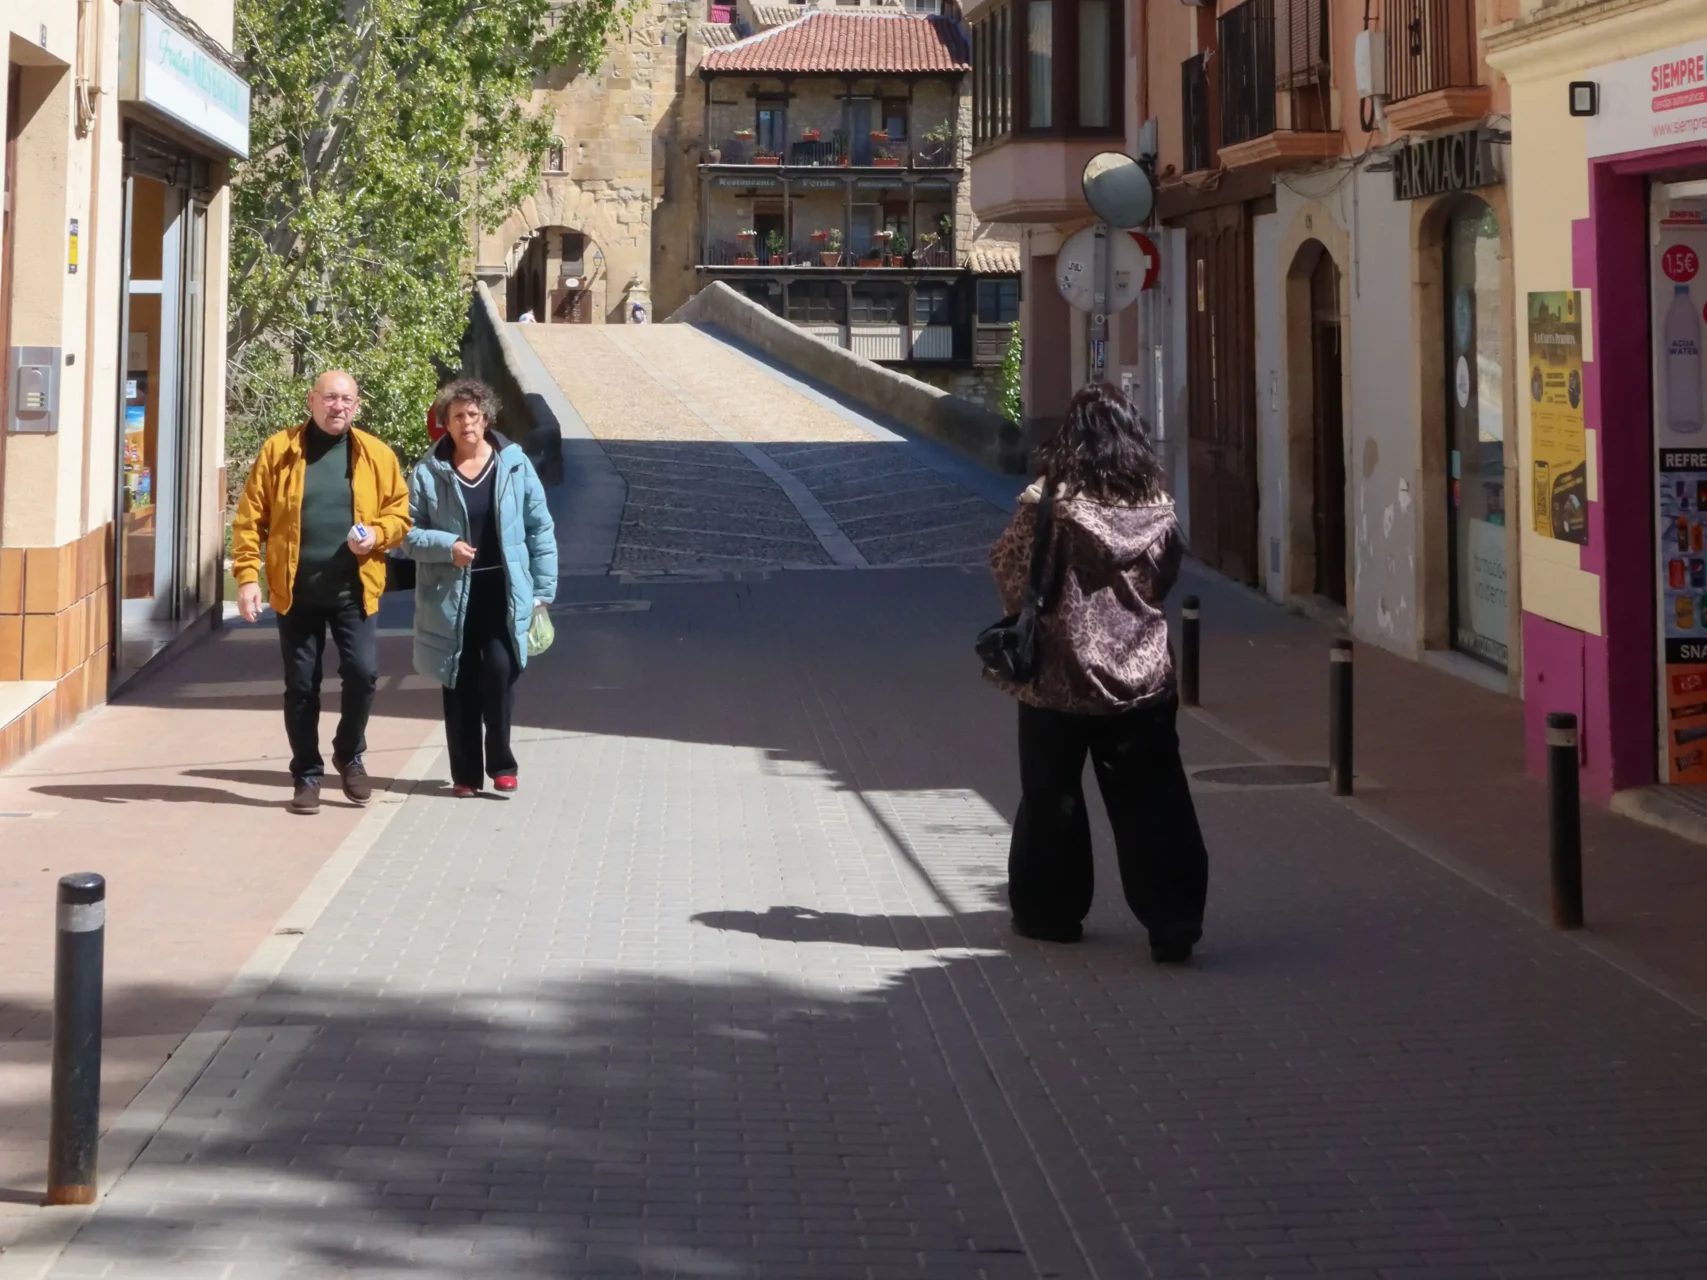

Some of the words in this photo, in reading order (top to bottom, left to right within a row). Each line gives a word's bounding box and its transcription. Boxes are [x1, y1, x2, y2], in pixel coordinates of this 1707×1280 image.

[1651, 55, 1704, 91] SIEMPRE
[1391, 131, 1485, 201] FARMACIA
[719, 179, 776, 187] Restaurante
[1666, 253, 1695, 276] 1,5€
